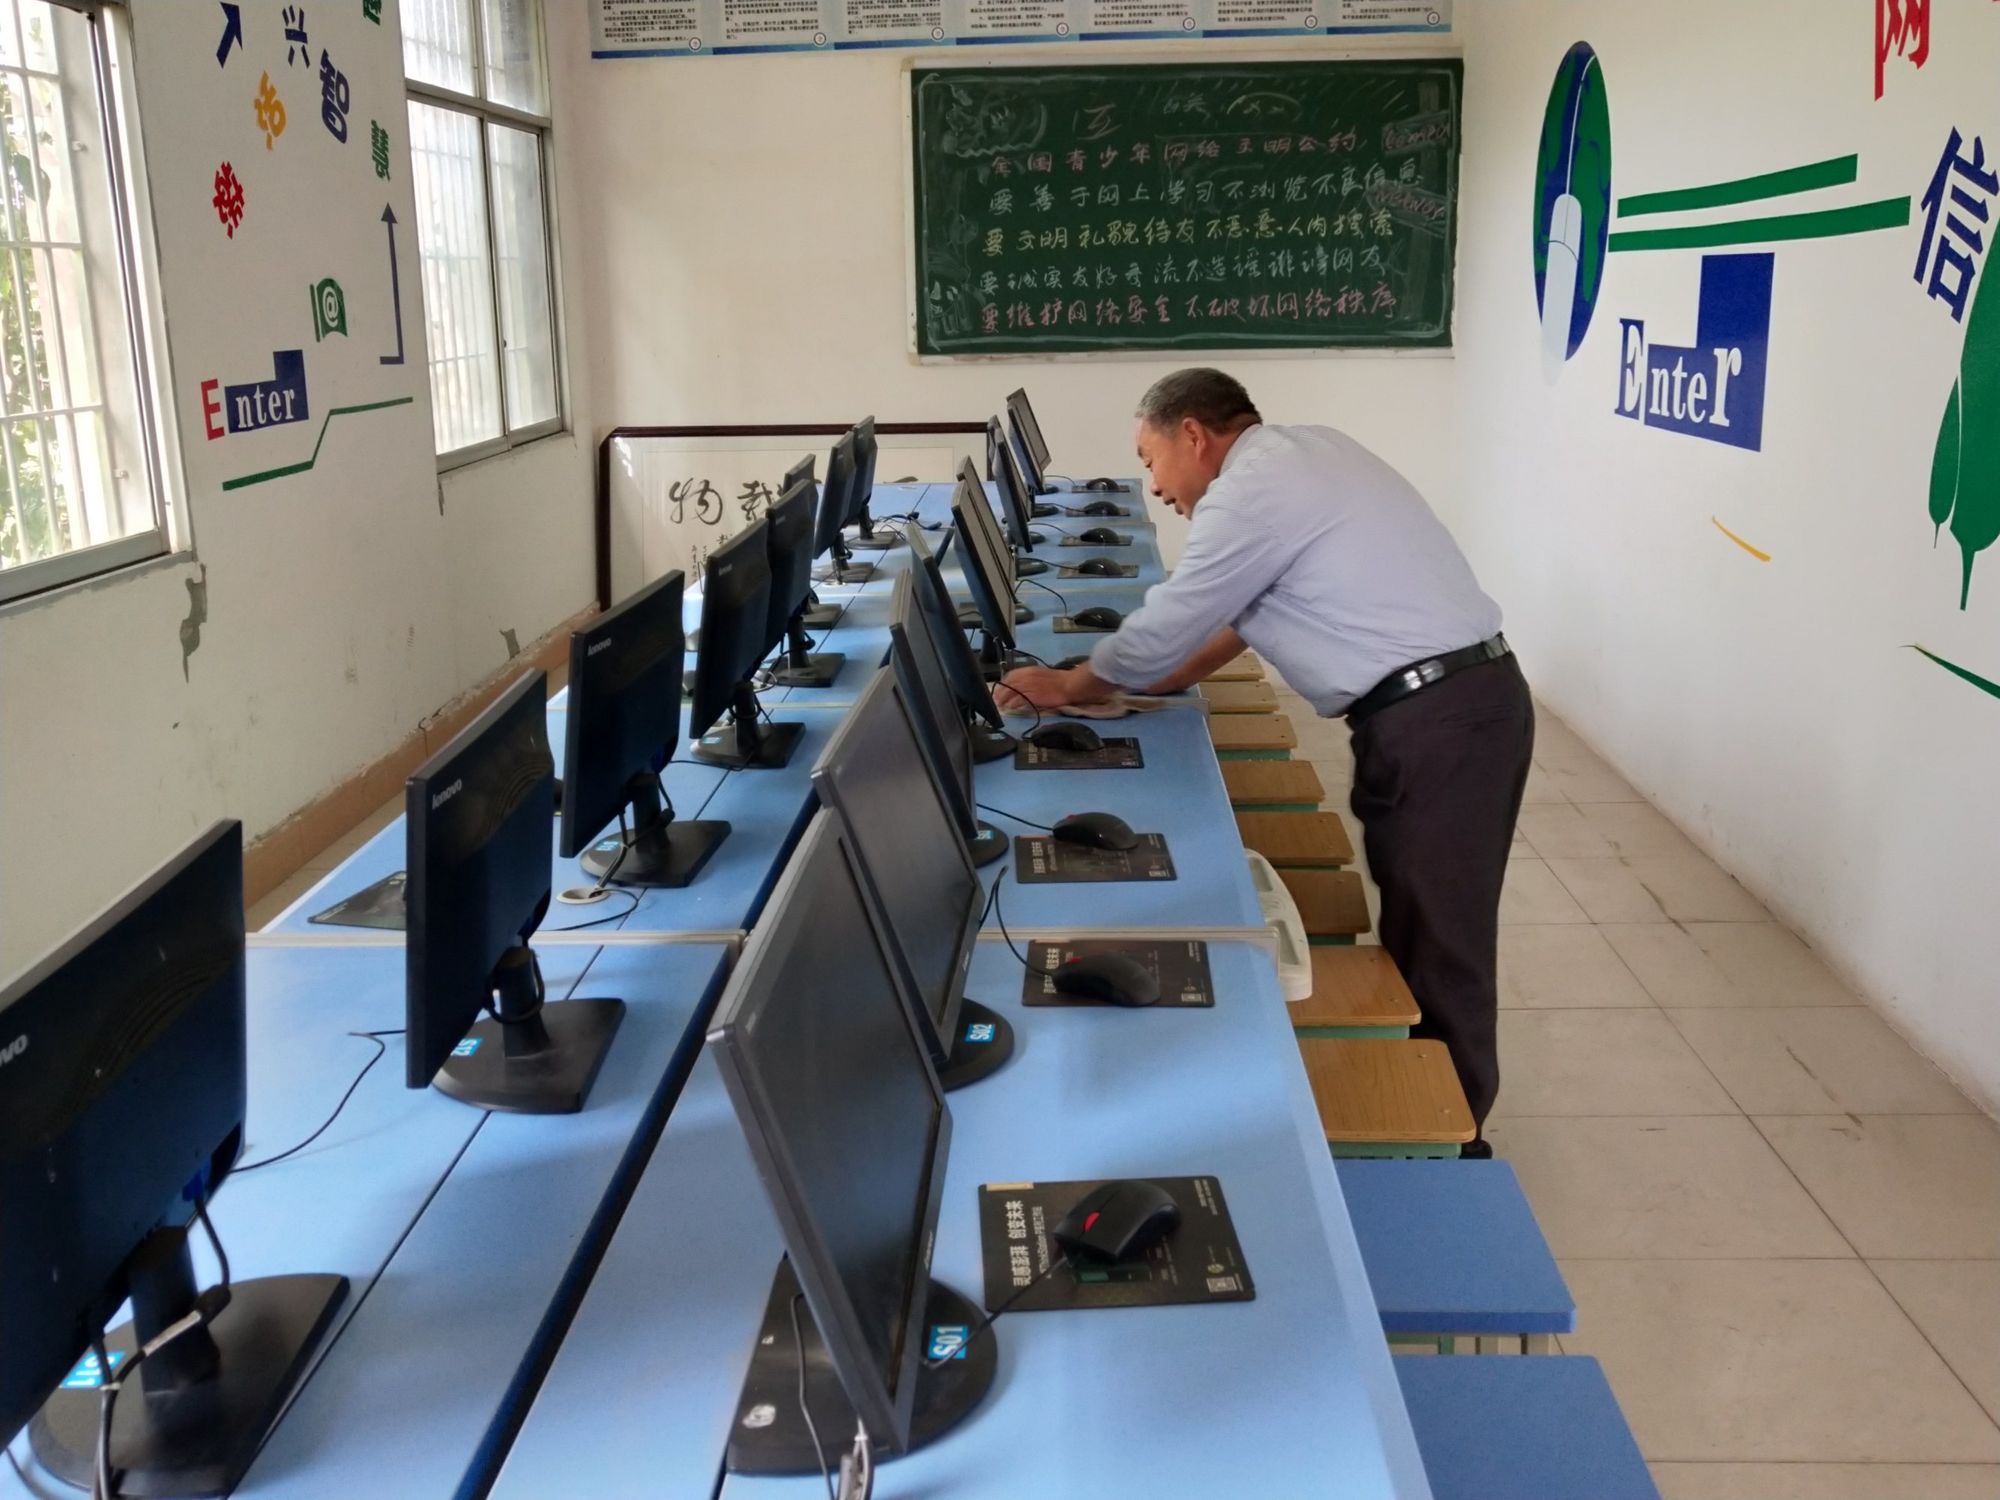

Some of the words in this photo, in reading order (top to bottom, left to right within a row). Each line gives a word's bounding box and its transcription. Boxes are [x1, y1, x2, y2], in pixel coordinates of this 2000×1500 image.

[1614, 318, 1742, 428] Enter
[200, 378, 297, 441] Enter
[431, 779, 462, 810] lenovo
[969, 1024, 993, 1040] S02
[932, 1326, 963, 1356] S01
